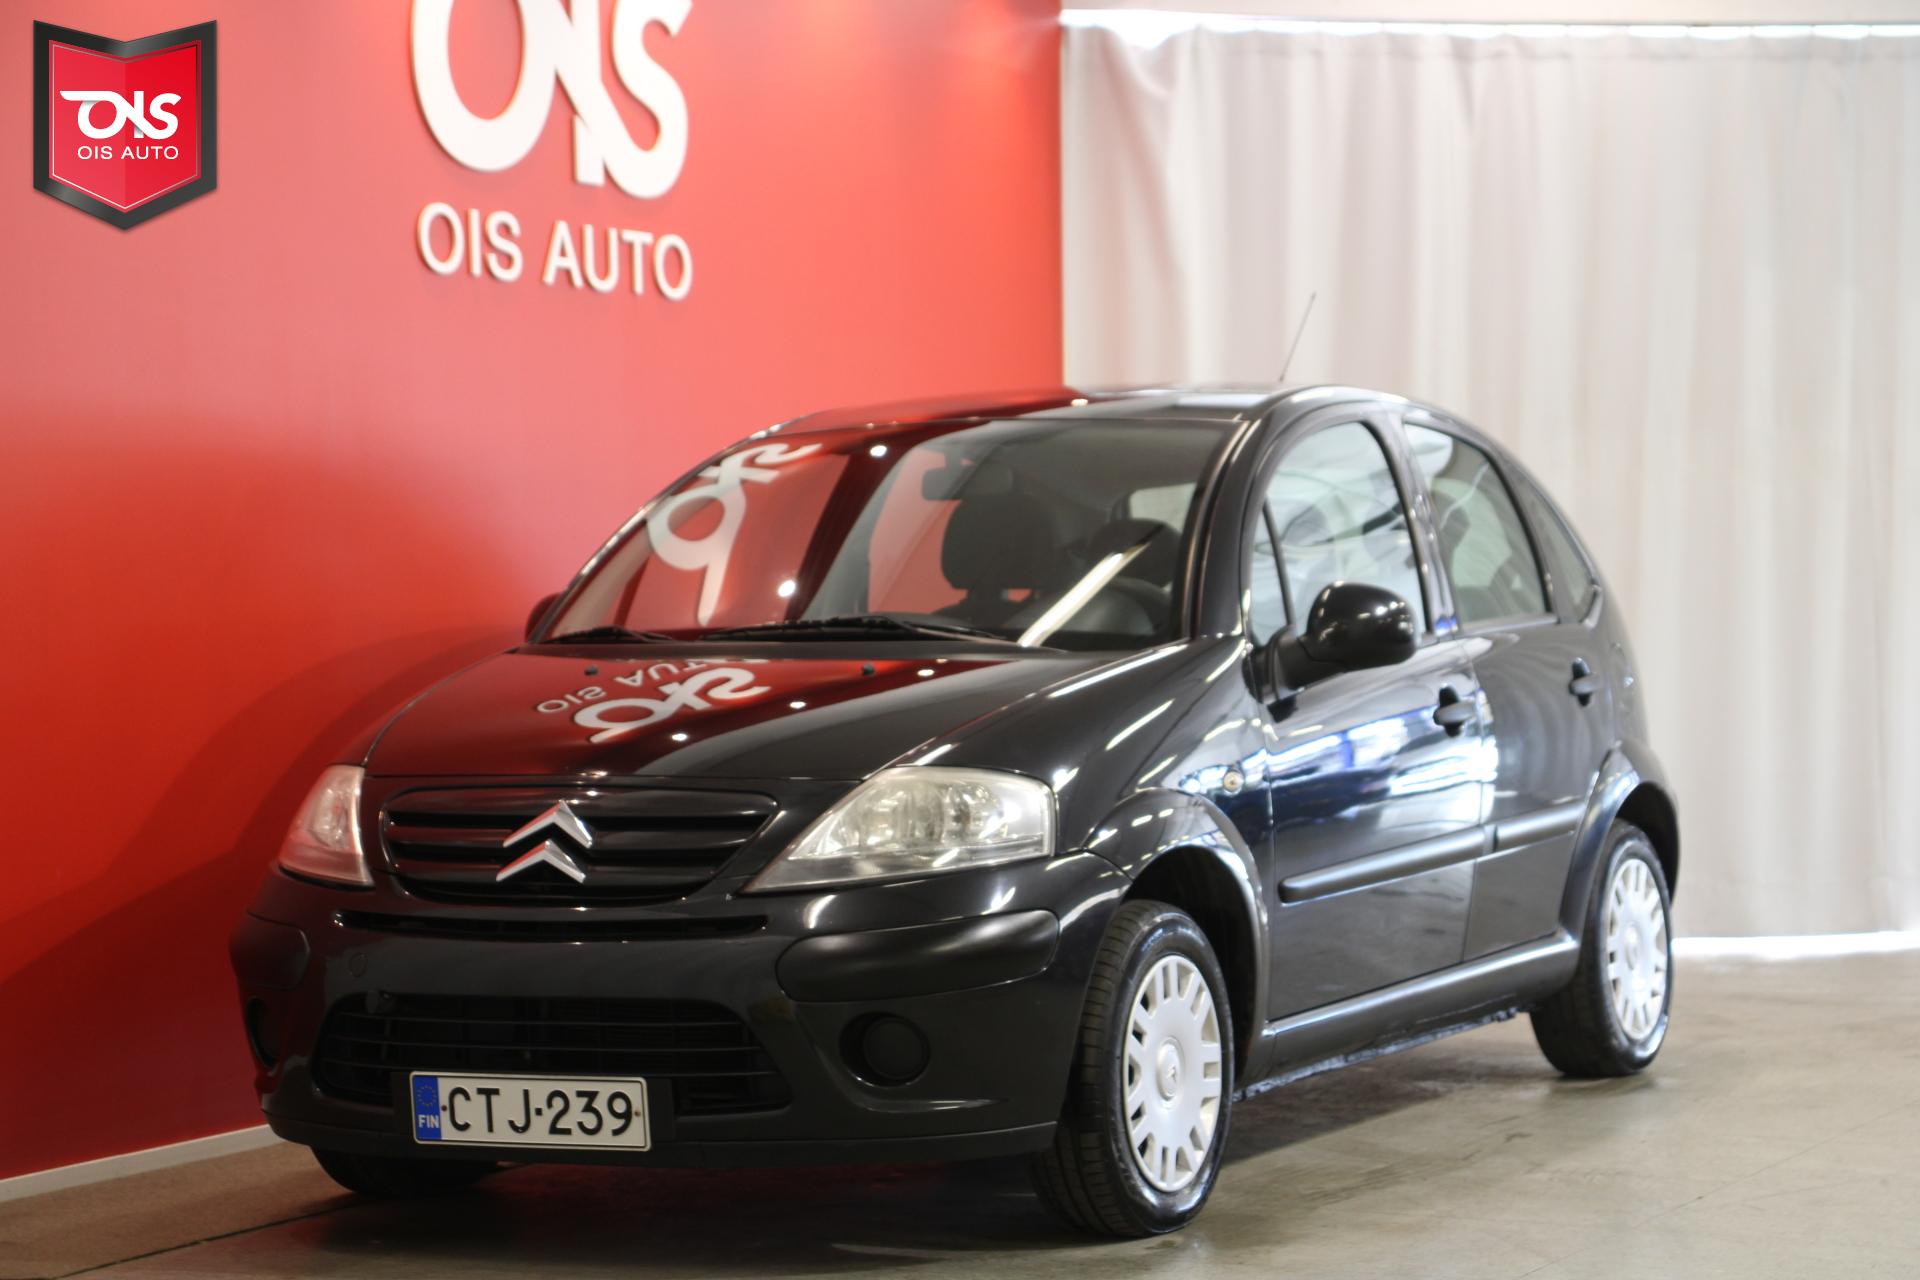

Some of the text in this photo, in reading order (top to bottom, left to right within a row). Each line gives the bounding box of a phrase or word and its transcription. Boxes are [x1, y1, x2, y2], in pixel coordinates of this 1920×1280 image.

[417, 202, 693, 300] OIS AUTO
[418, 1114, 440, 1129] FIN
